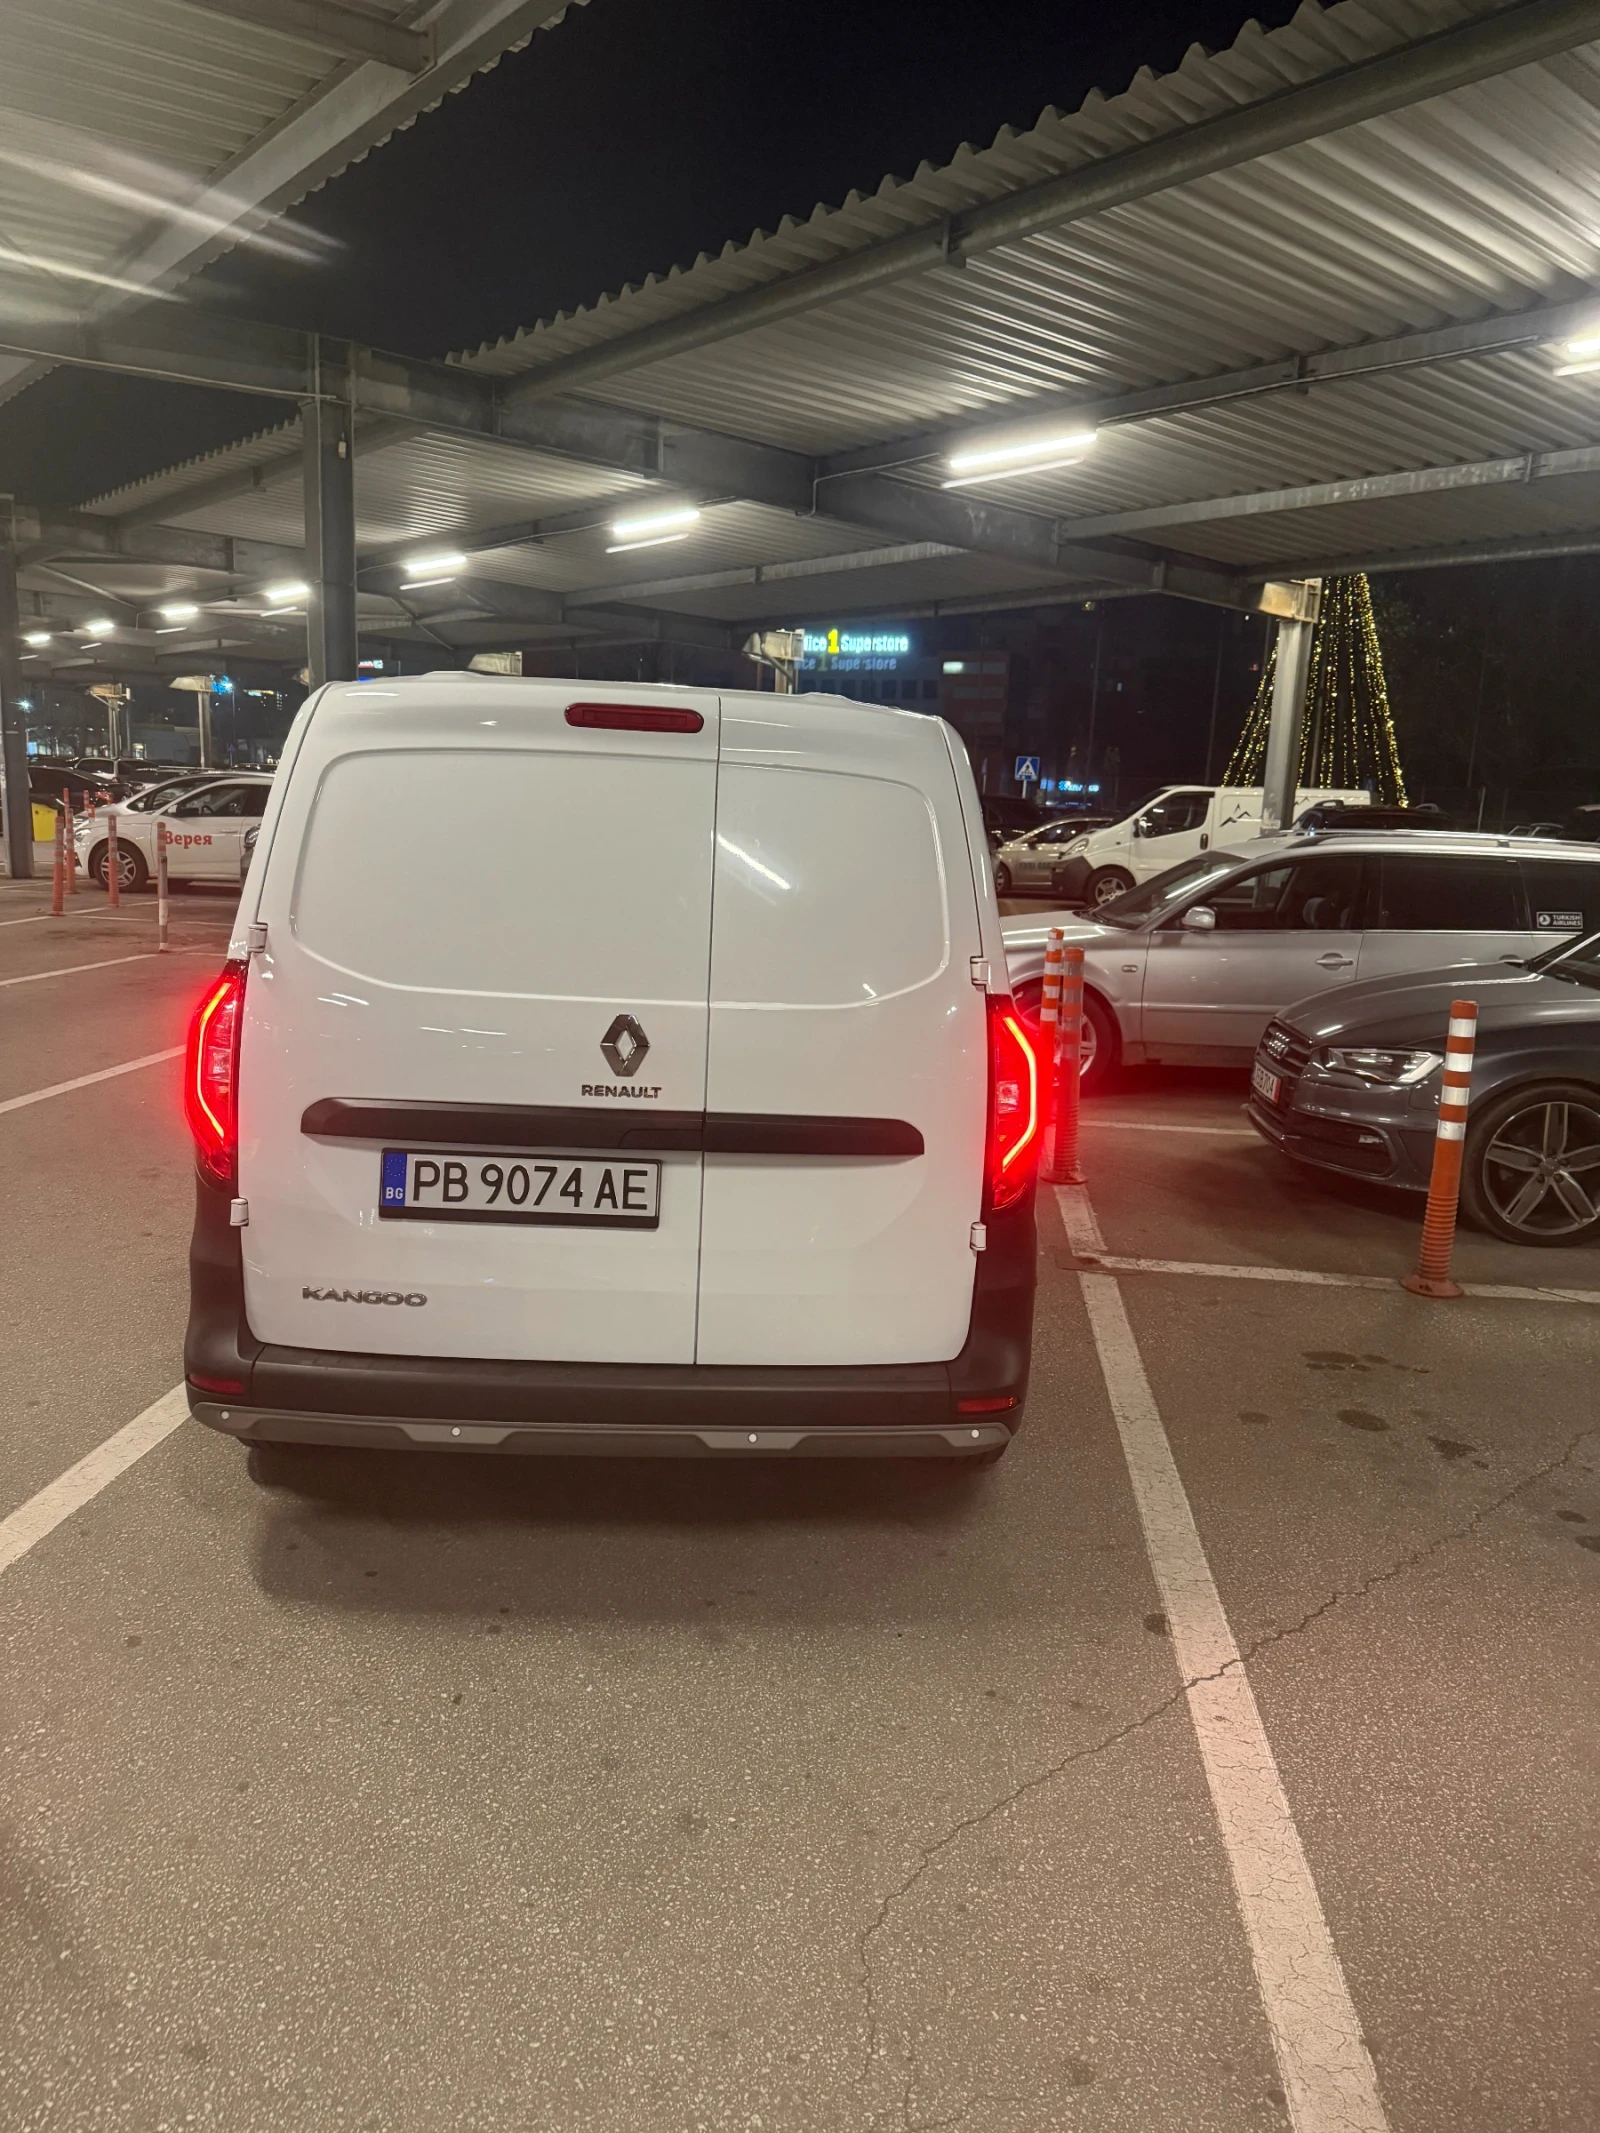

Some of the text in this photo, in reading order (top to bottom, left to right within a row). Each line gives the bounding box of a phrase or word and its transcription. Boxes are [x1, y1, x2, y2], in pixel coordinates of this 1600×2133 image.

[828, 629, 839, 653] 1
[841, 634, 909, 653] Superstore
[165, 830, 213, 850] Верея
[581, 1084, 663, 1099] RENAULT
[385, 1186, 404, 1200] BG
[412, 1160, 648, 1210] PB 9074 AE
[302, 1286, 428, 1307] KANGOO
